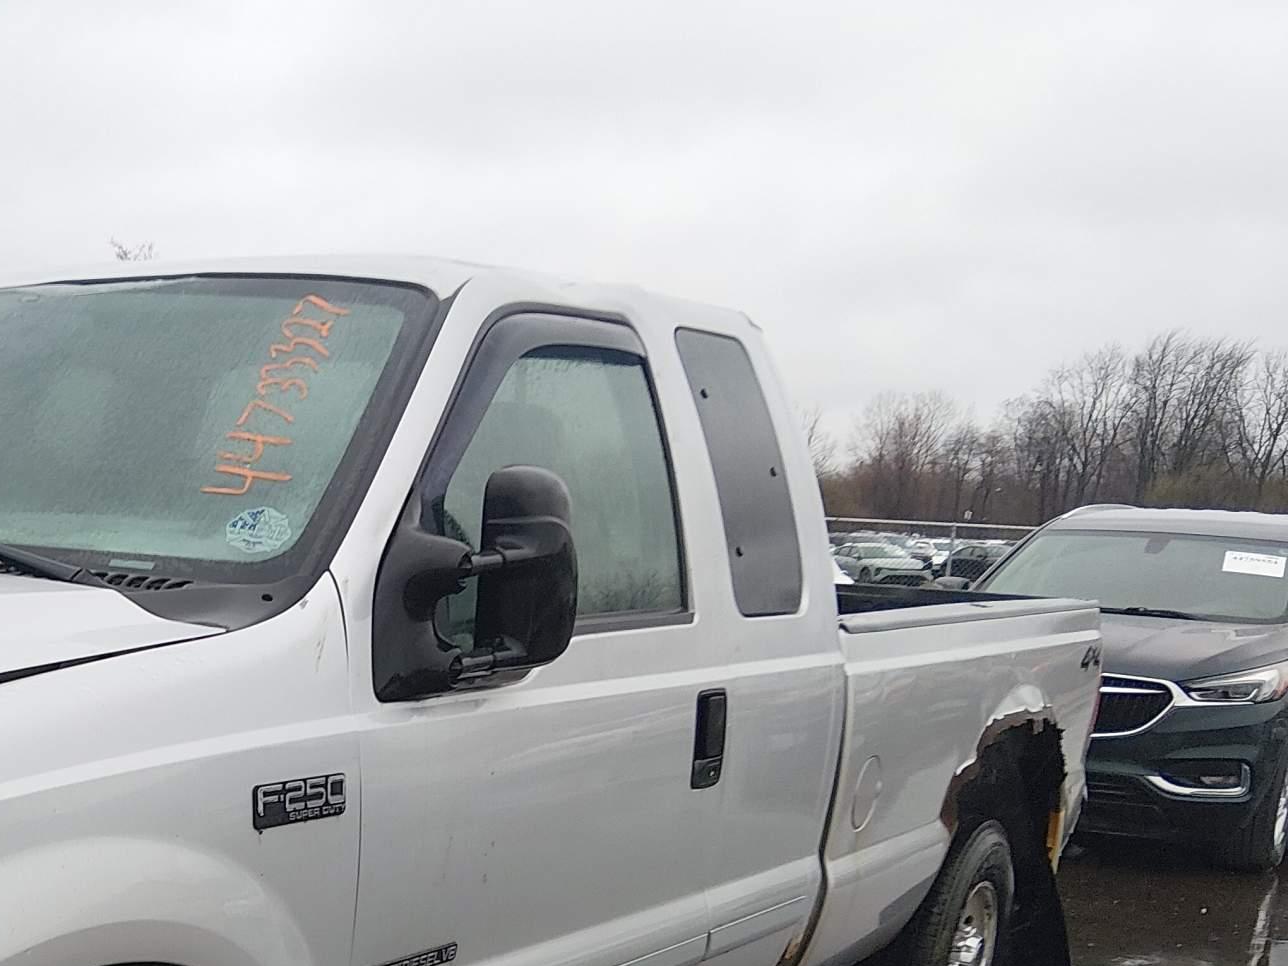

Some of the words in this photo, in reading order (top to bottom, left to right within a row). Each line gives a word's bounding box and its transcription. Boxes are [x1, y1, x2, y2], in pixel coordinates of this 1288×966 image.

[200, 293, 352, 495] 44733327
[257, 775, 345, 817] F-250
[289, 807, 321, 821] SUPER
[322, 803, 345, 815] DUTY
